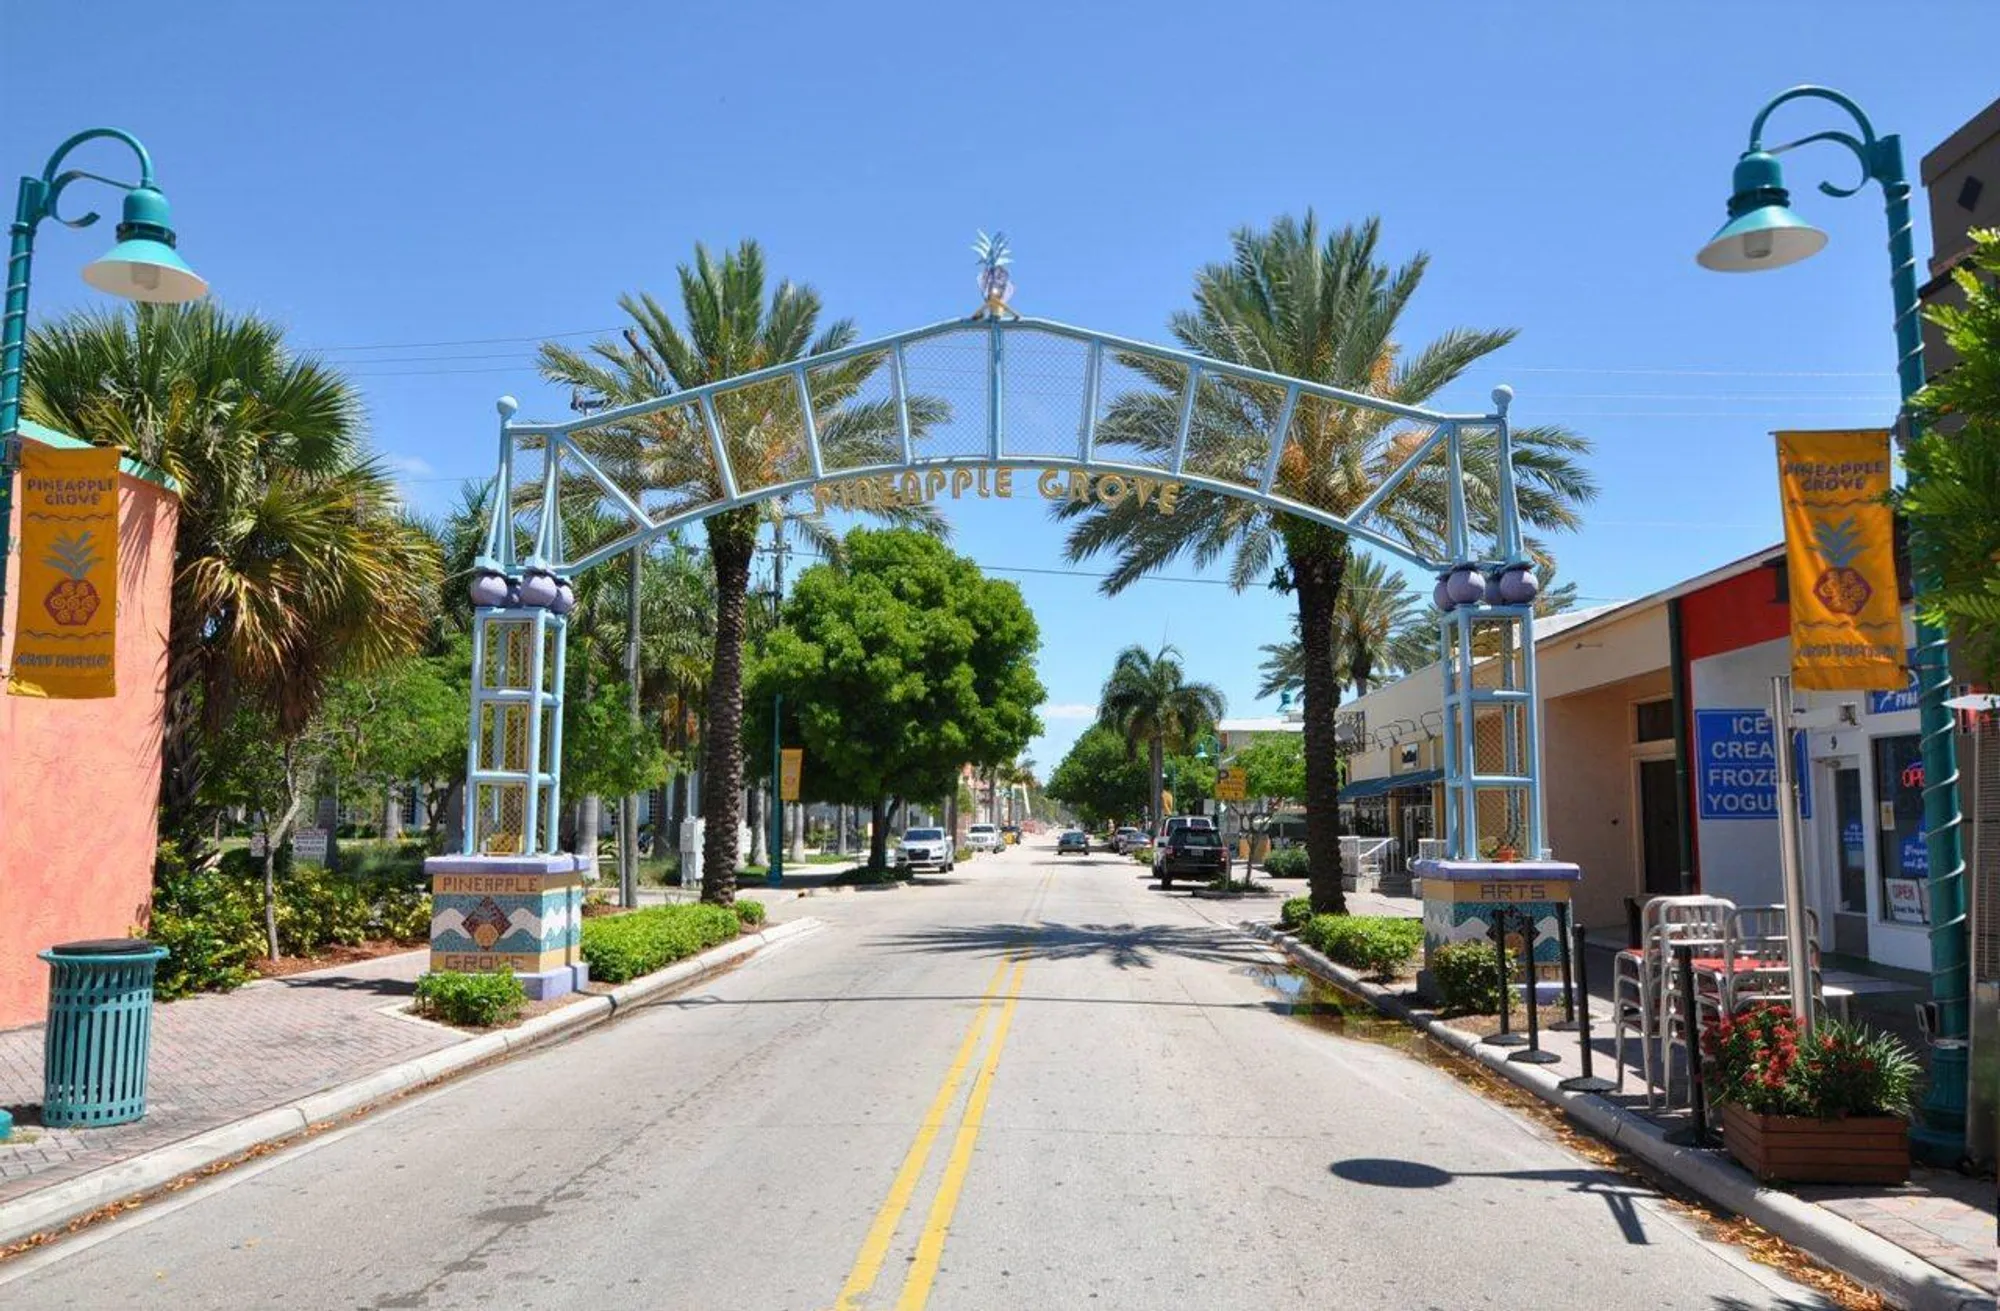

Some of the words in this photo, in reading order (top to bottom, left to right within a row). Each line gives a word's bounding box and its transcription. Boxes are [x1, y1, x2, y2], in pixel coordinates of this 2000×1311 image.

[44, 494, 100, 505] GROVE
[813, 467, 1013, 516] PINEAPPLE
[1038, 468, 1181, 515] GROVE
[1732, 717, 1769, 734] ICE
[1711, 741, 1775, 758] CREA
[1708, 769, 1779, 786] FROZE
[1707, 793, 1782, 811] YOGU
[442, 876, 538, 892] PINEAPPLE
[1481, 884, 1545, 899] ARTS
